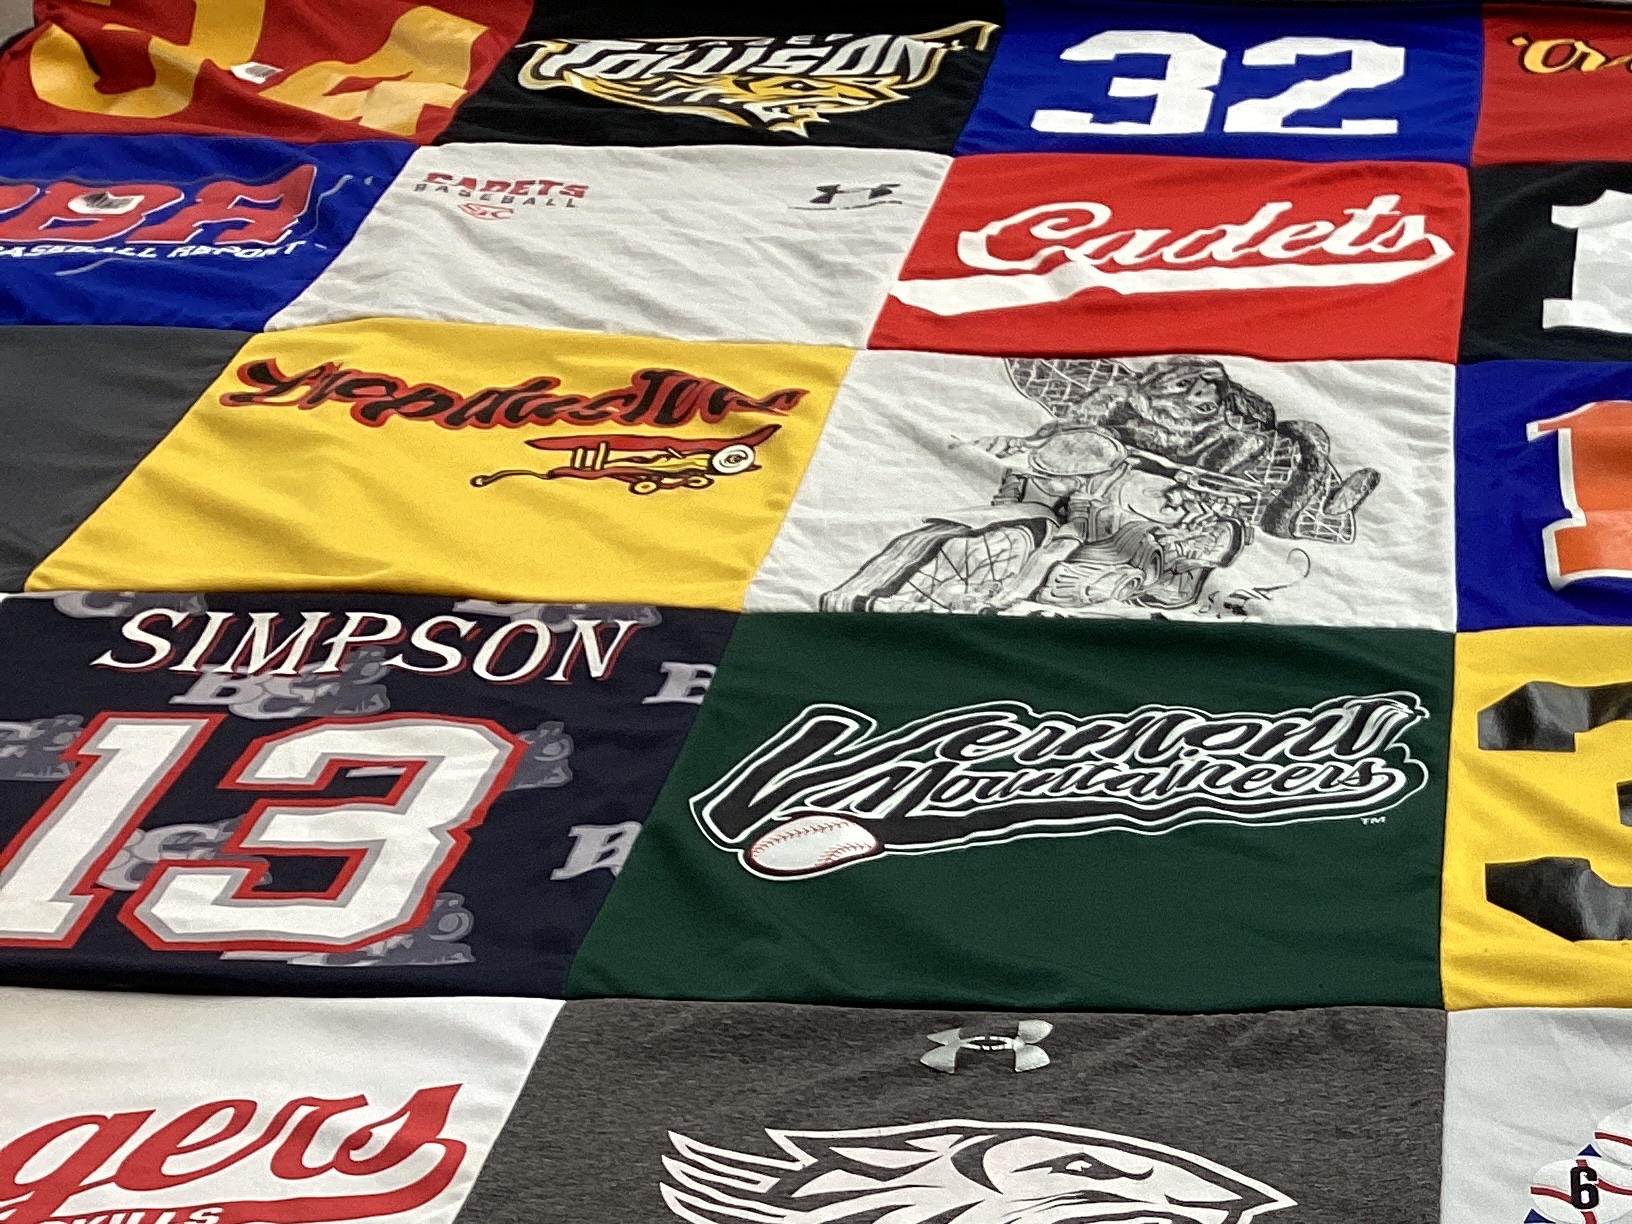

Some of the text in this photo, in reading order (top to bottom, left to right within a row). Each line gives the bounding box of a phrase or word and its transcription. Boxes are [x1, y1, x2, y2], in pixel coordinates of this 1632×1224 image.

[1031, 30, 1406, 135] 32
[413, 183, 577, 209] BASEBALL
[423, 172, 590, 199] CADETS
[0, 245, 157, 258] ASEBALL
[945, 195, 1453, 290] Cadets
[91, 609, 642, 684] SIMPSON
[692, 694, 1425, 846] Vermont
[800, 755, 1402, 822] Mountaineers
[0, 711, 526, 952] 13
[1569, 1166, 1601, 1211] 6
